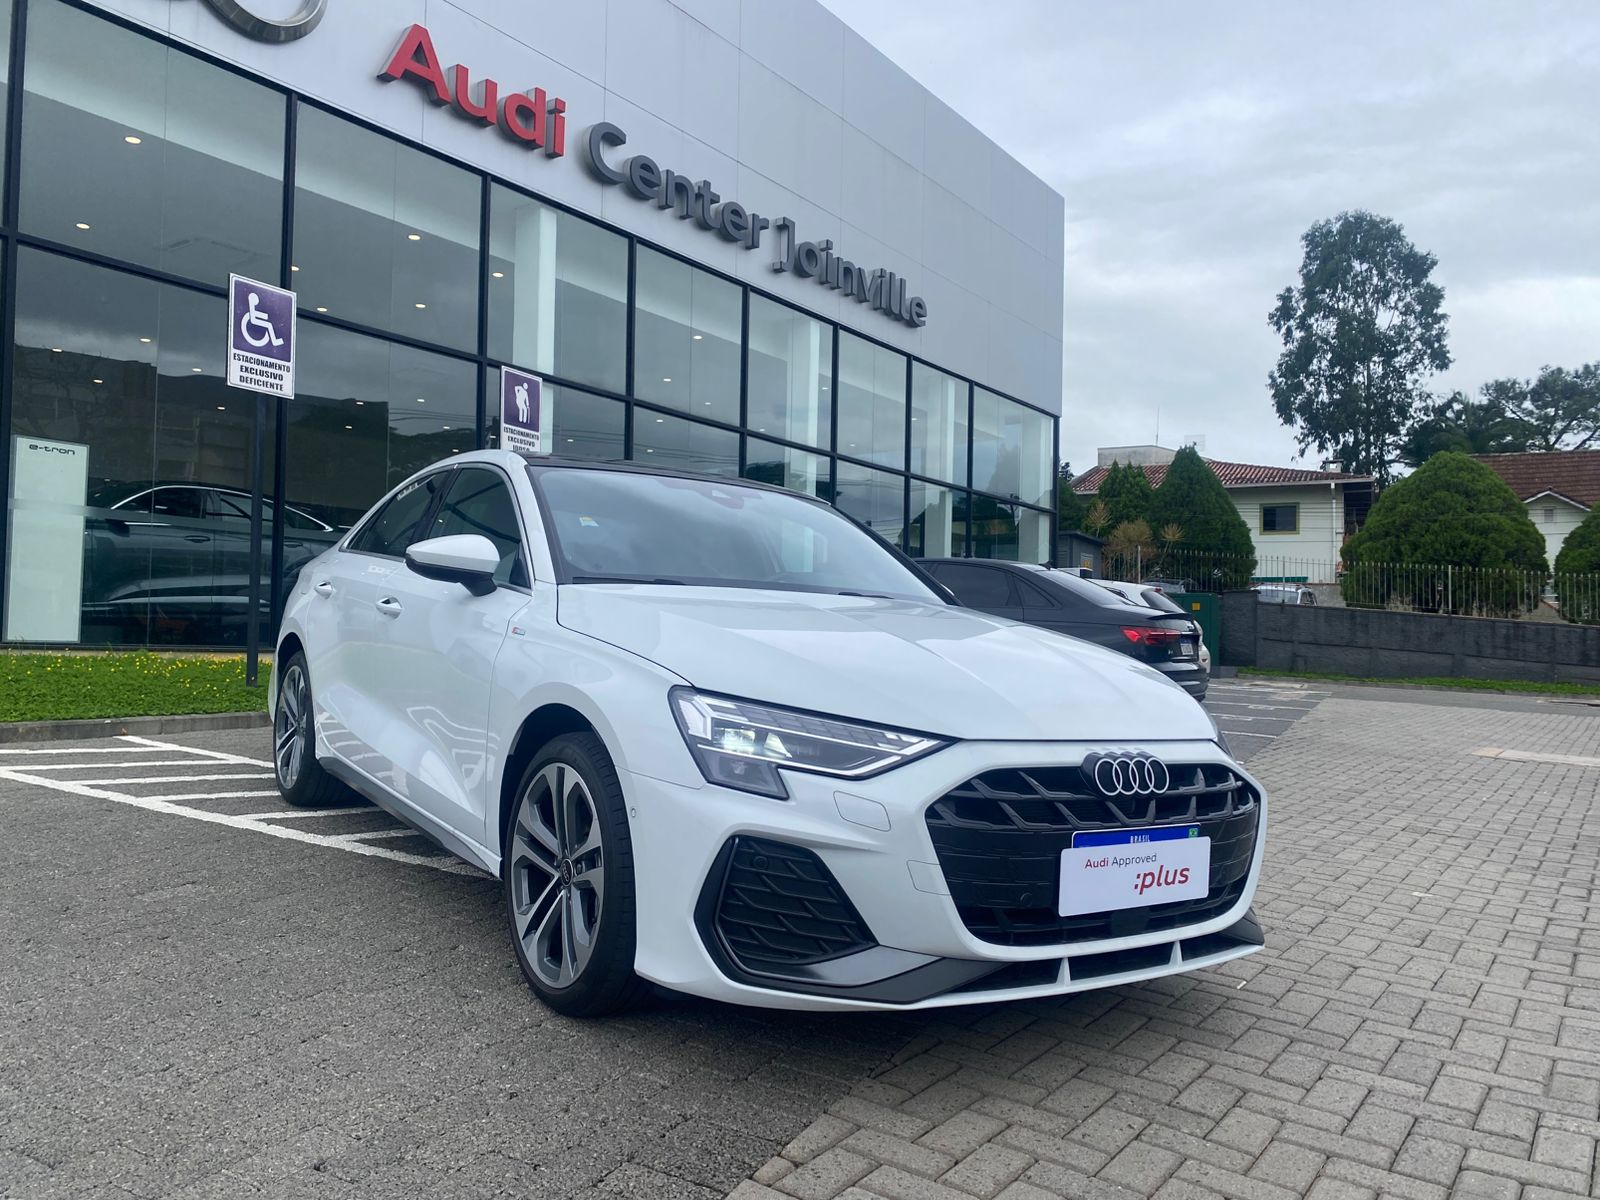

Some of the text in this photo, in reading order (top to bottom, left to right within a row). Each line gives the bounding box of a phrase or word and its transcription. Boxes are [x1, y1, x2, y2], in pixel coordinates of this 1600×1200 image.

[376, 23, 928, 328] Audi Center Joinville
[233, 352, 291, 373] ESTACIONAMENTO
[240, 365, 284, 381] EXCLUSIVO
[239, 375, 284, 391] DEFICIENTE
[503, 426, 539, 440] ESTACIONAMENTO
[507, 435, 536, 447] EXCLUSIVO
[29, 444, 75, 455] e-tron
[1130, 834, 1151, 844] BRASIL
[1084, 853, 1157, 869] Audi Approved
